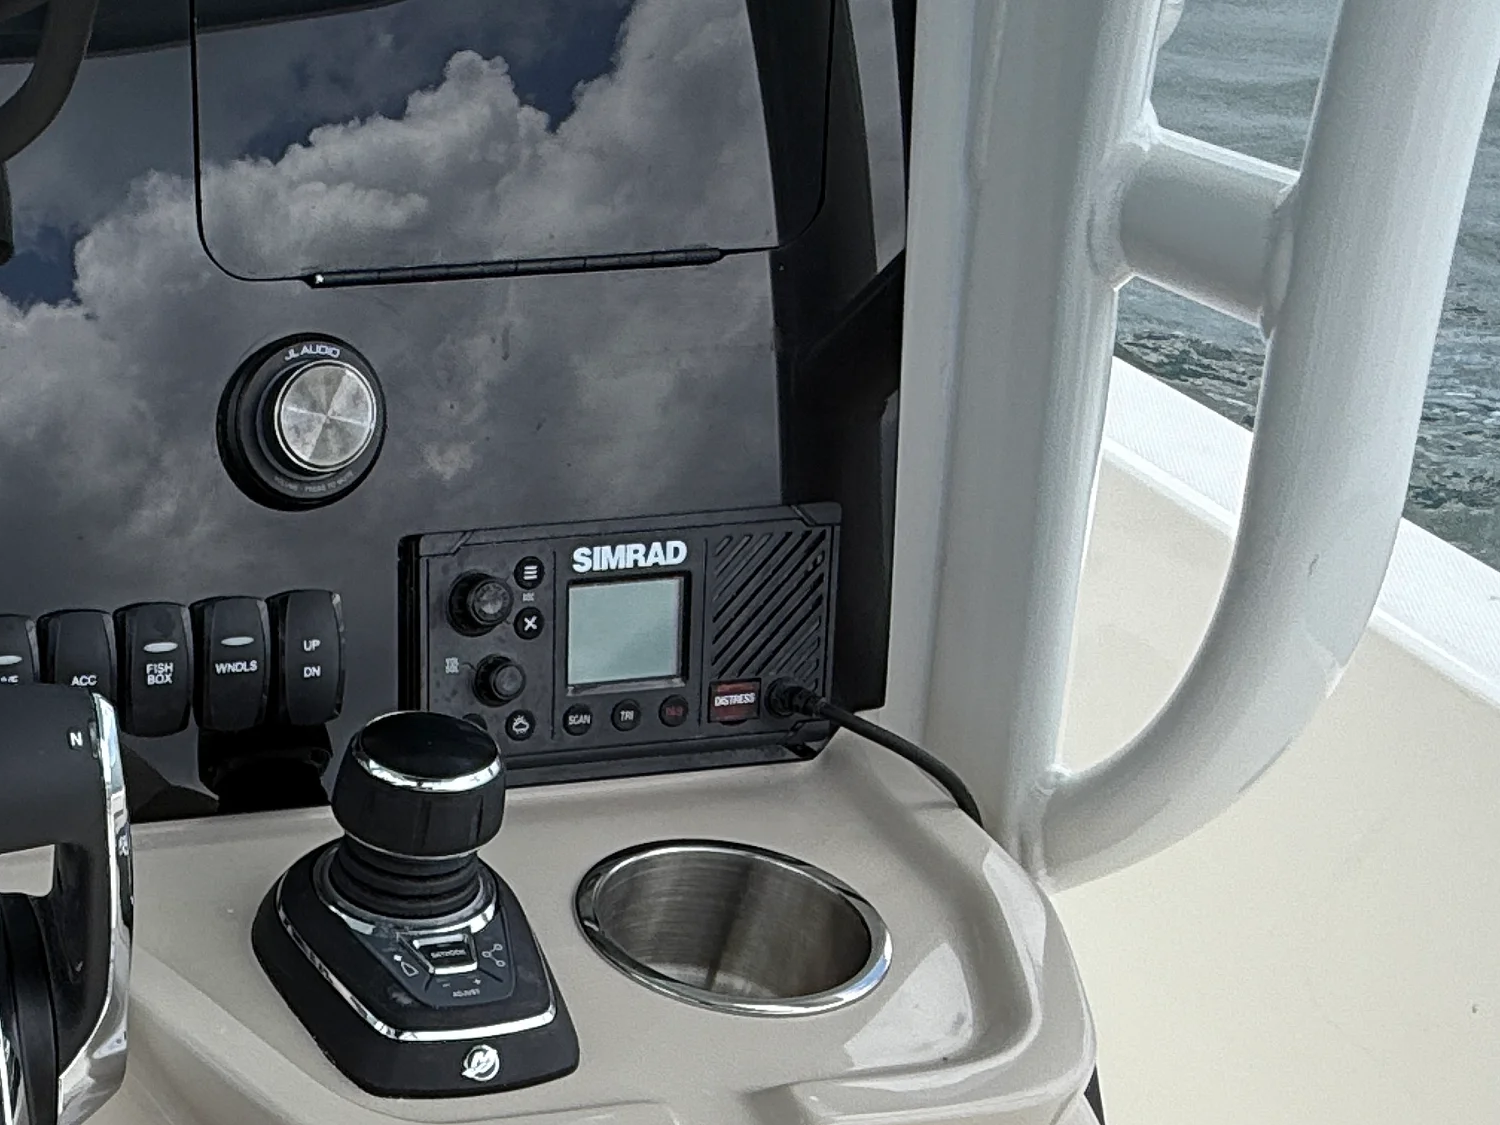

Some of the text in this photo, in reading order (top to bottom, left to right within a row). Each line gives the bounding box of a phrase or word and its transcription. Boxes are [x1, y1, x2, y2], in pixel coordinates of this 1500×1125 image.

[284, 344, 341, 361] JL AUDIO
[572, 540, 688, 573] SIMRAD
[303, 639, 321, 651] UP
[146, 662, 174, 674] FISH
[215, 660, 258, 674] WNDLS
[303, 666, 321, 678] DN
[70, 675, 98, 686] ACC
[147, 673, 173, 685] BOX
[714, 692, 756, 707] DISTRESS
[568, 714, 591, 725] SCAN
[620, 710, 635, 721] TRI
[69, 731, 84, 747] N
